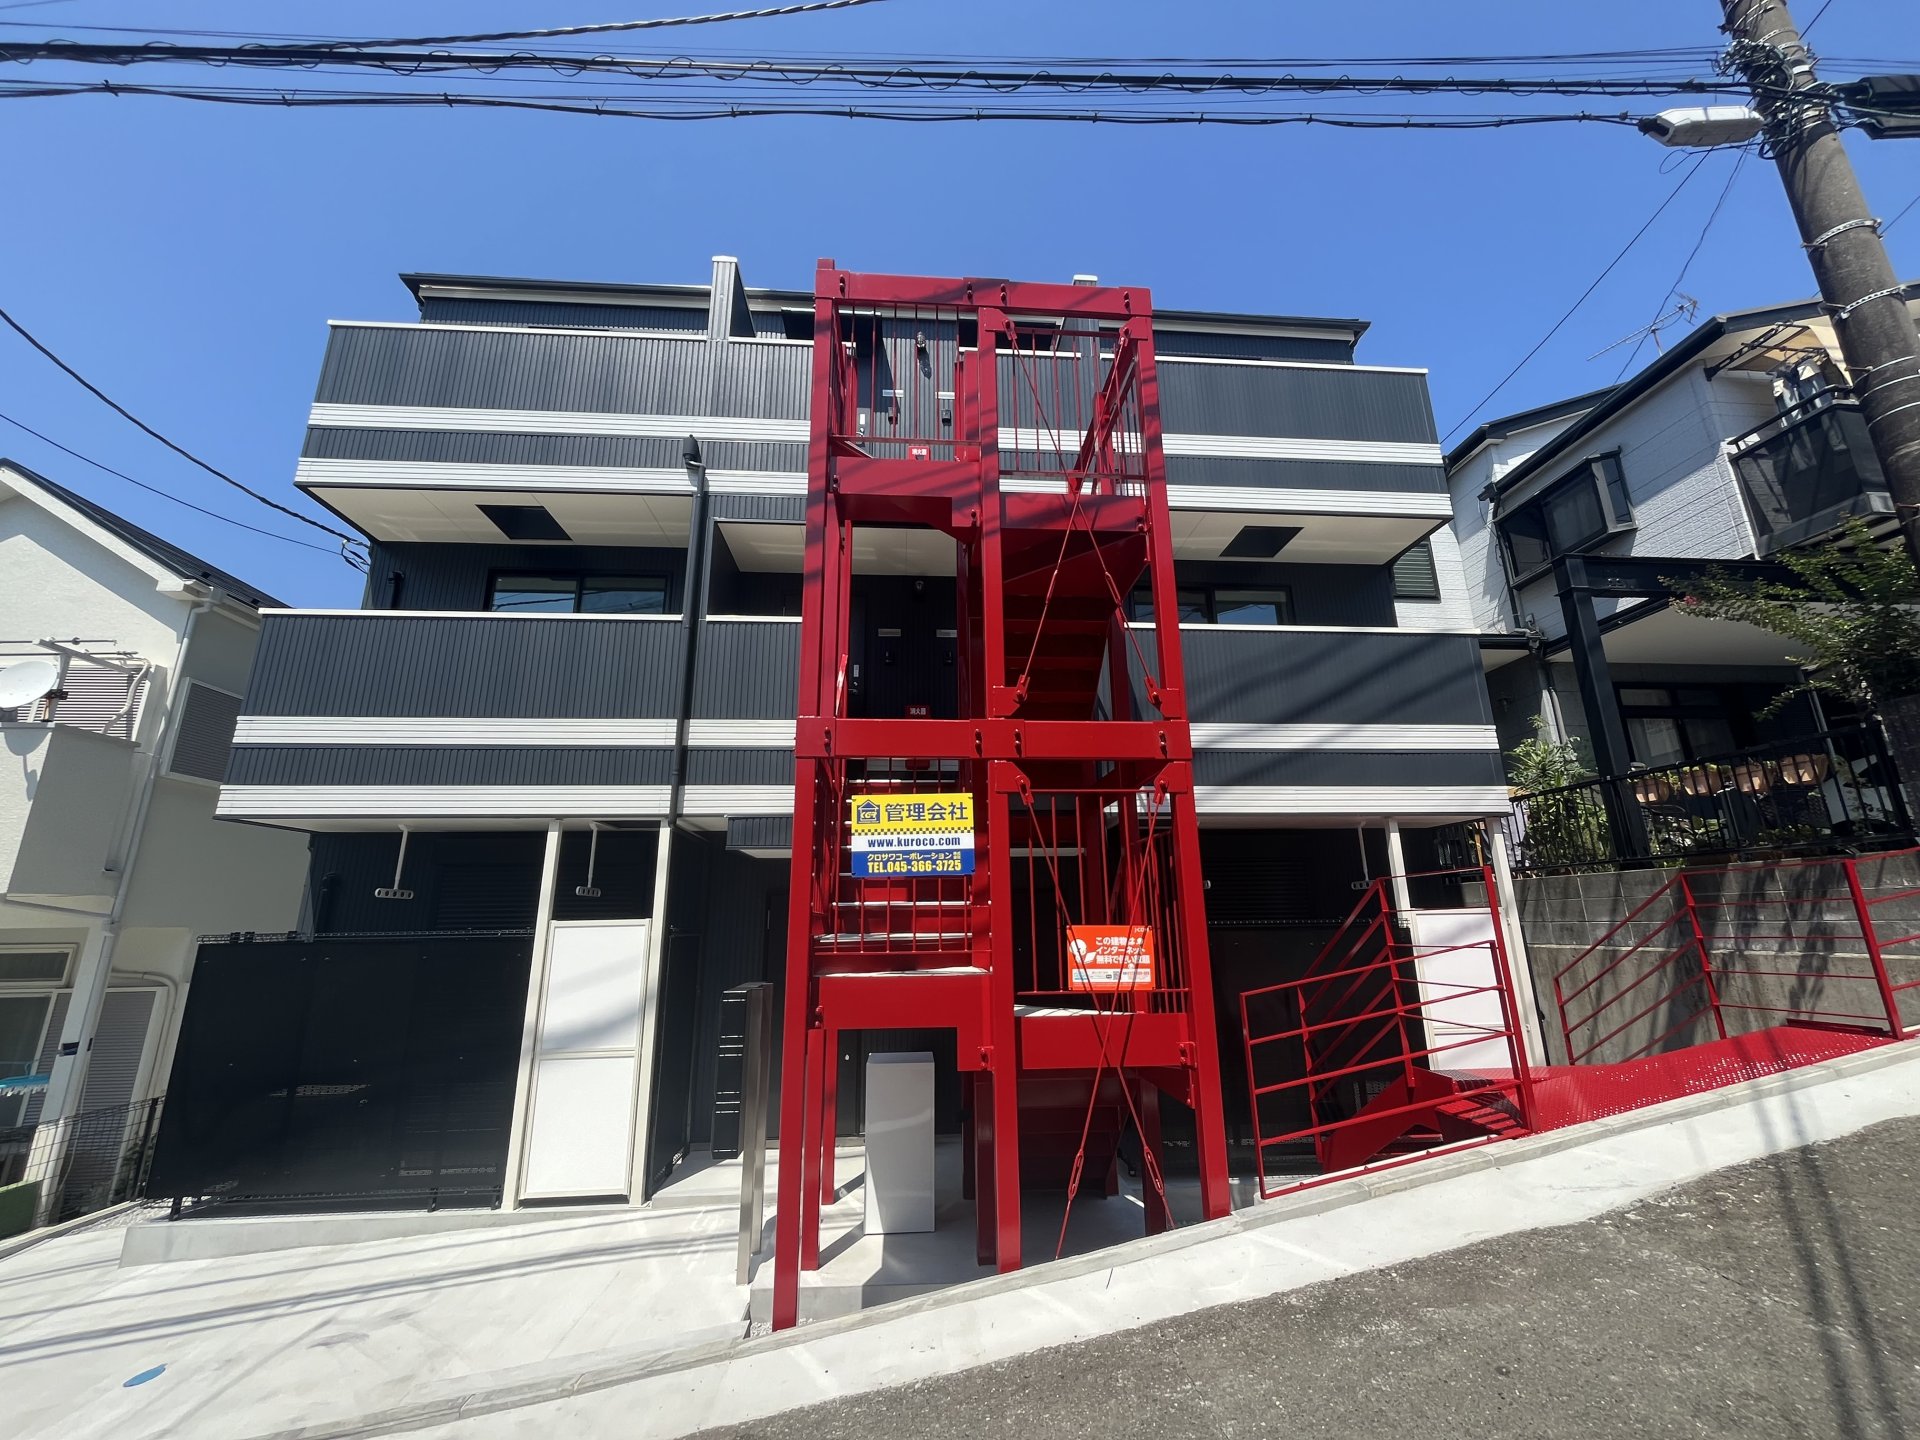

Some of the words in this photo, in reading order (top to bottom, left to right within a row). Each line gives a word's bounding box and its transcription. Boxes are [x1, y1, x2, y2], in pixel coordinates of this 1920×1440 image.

[885, 802, 968, 822] 管理会社
[867, 836, 961, 848] www.kuroco.com
[867, 852, 952, 861] クロサワコーポレーション
[867, 860, 961, 873] TEL.045-366-3725
